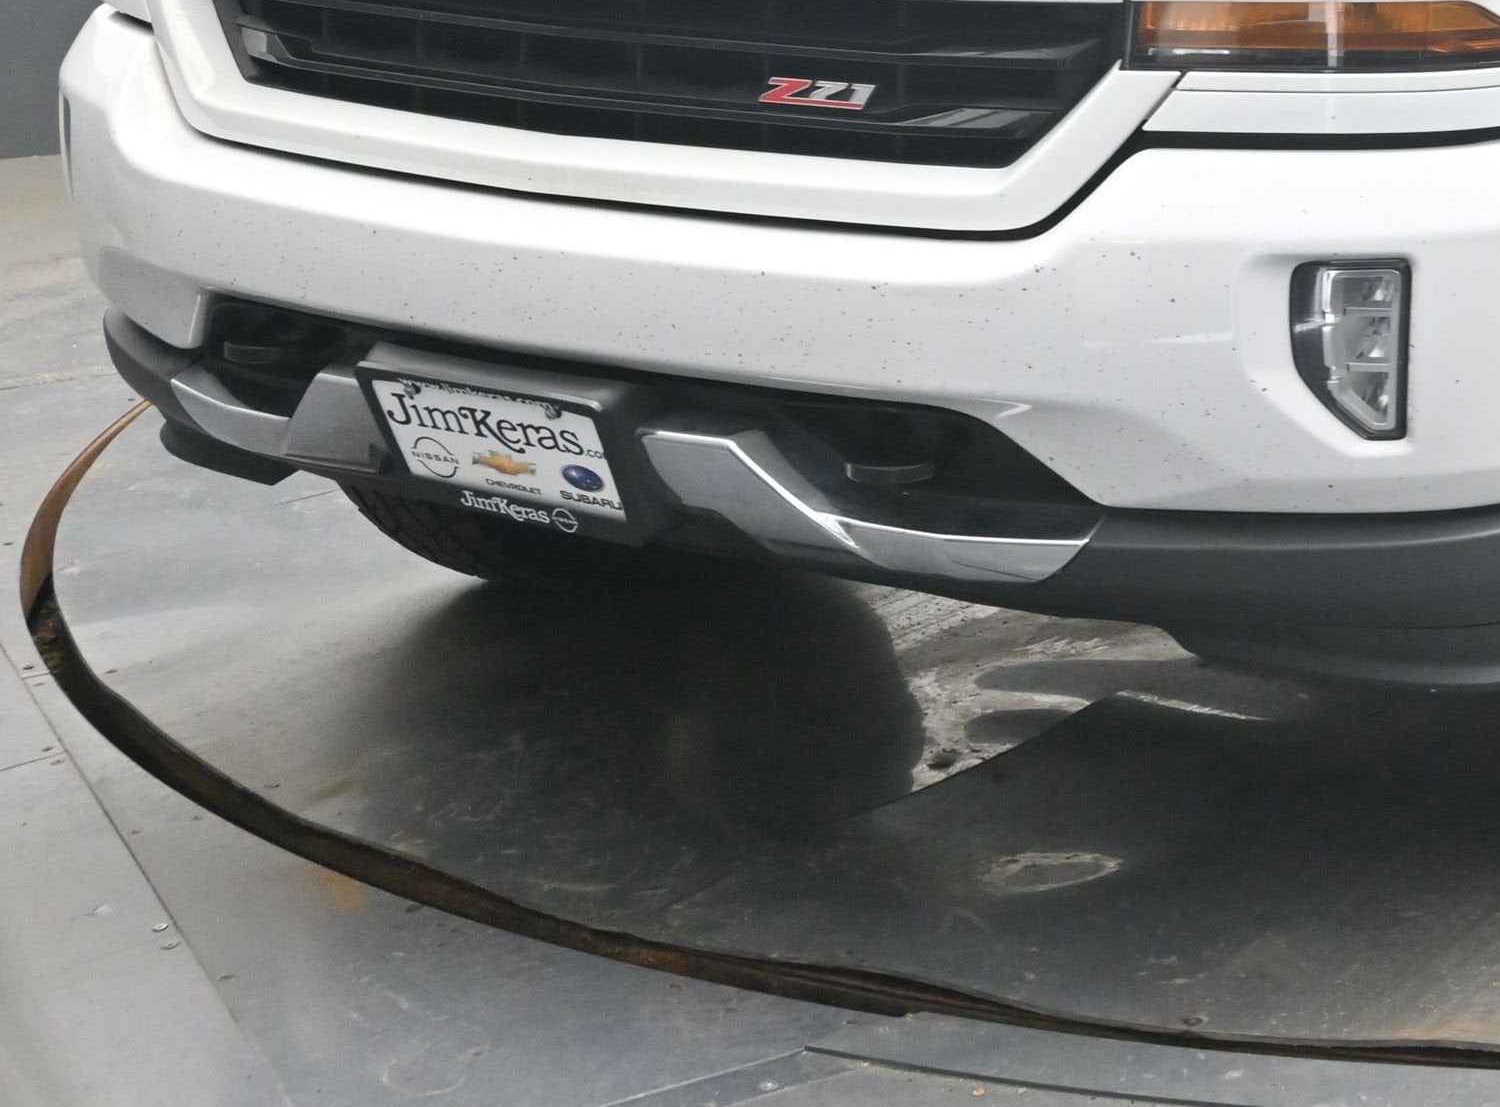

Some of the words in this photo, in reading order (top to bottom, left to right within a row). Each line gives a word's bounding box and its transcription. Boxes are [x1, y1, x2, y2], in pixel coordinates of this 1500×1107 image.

[758, 77, 877, 110] Z71
[411, 451, 459, 464] NISSAN
[485, 478, 542, 495] CHEVROLET
[560, 490, 622, 510] SUBARU
